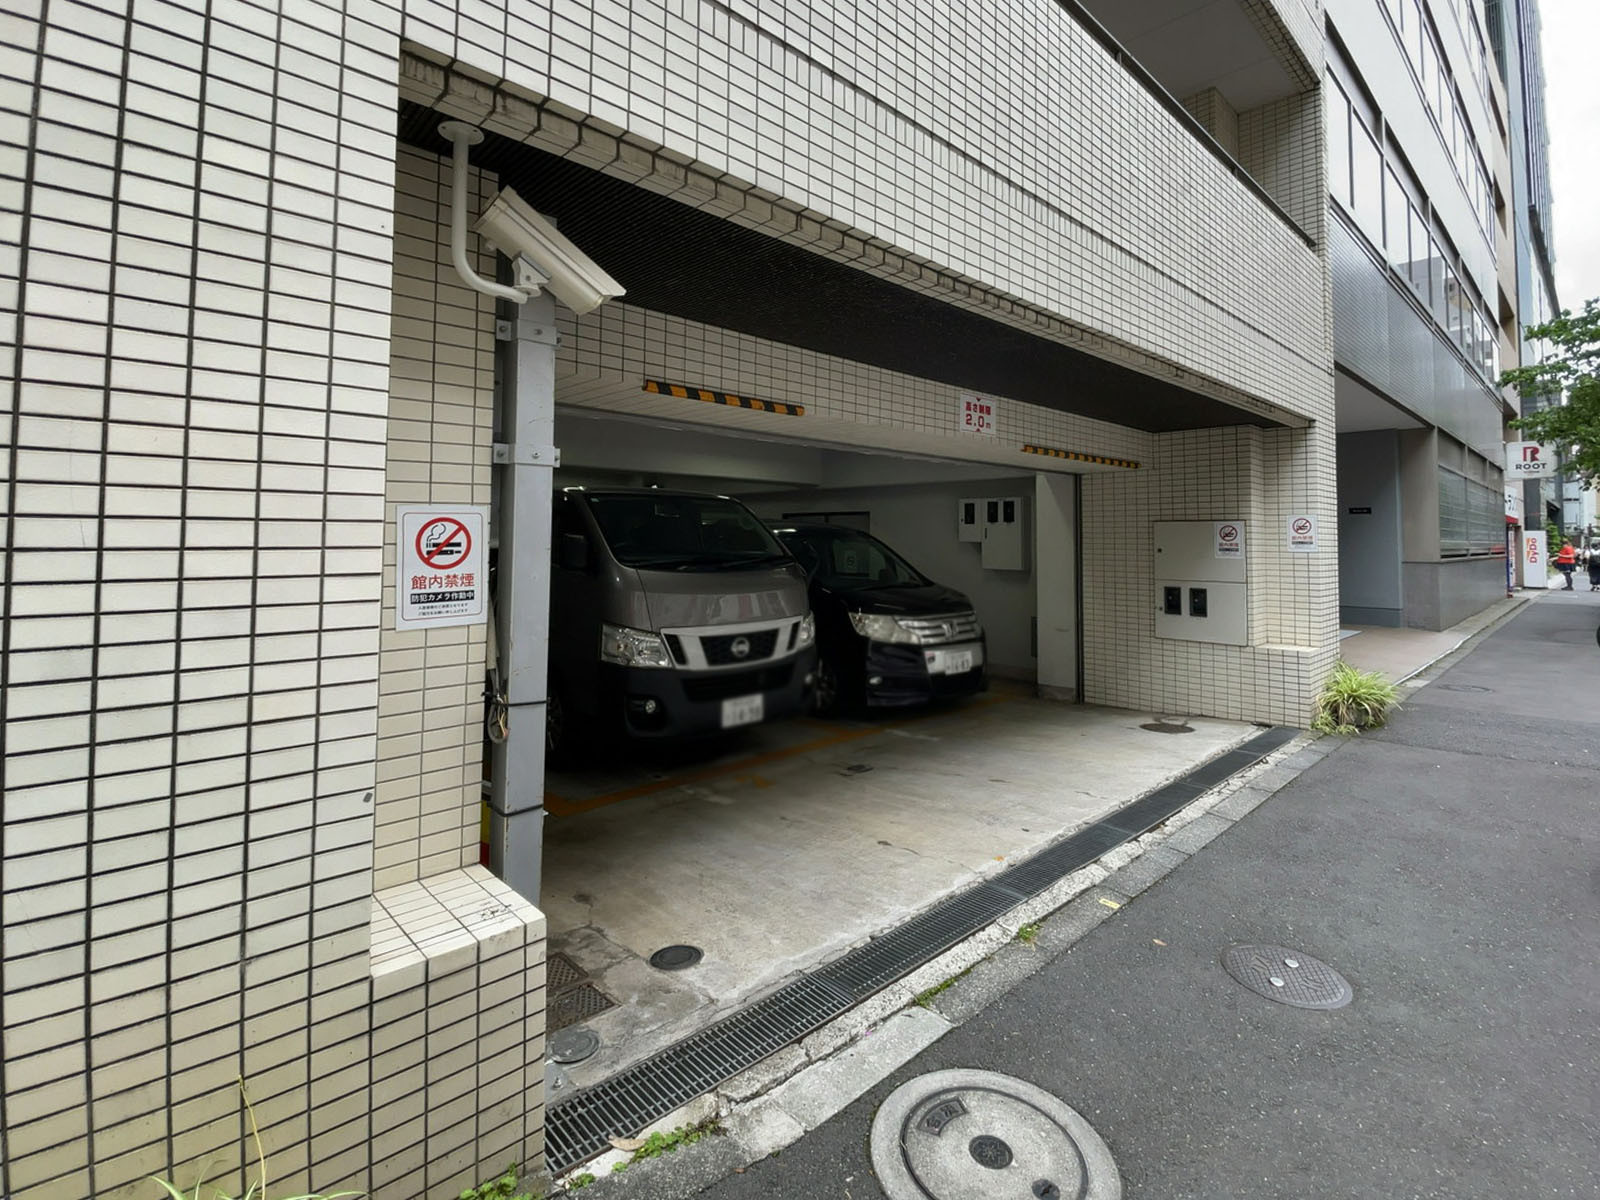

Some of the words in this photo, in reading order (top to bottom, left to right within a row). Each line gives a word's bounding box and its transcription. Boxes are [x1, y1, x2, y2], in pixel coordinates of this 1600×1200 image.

[1529, 537, 1539, 564] DyDo
[411, 573, 475, 590] 館内禁煙
[411, 591, 474, 603] 防犯カメラ作動中
